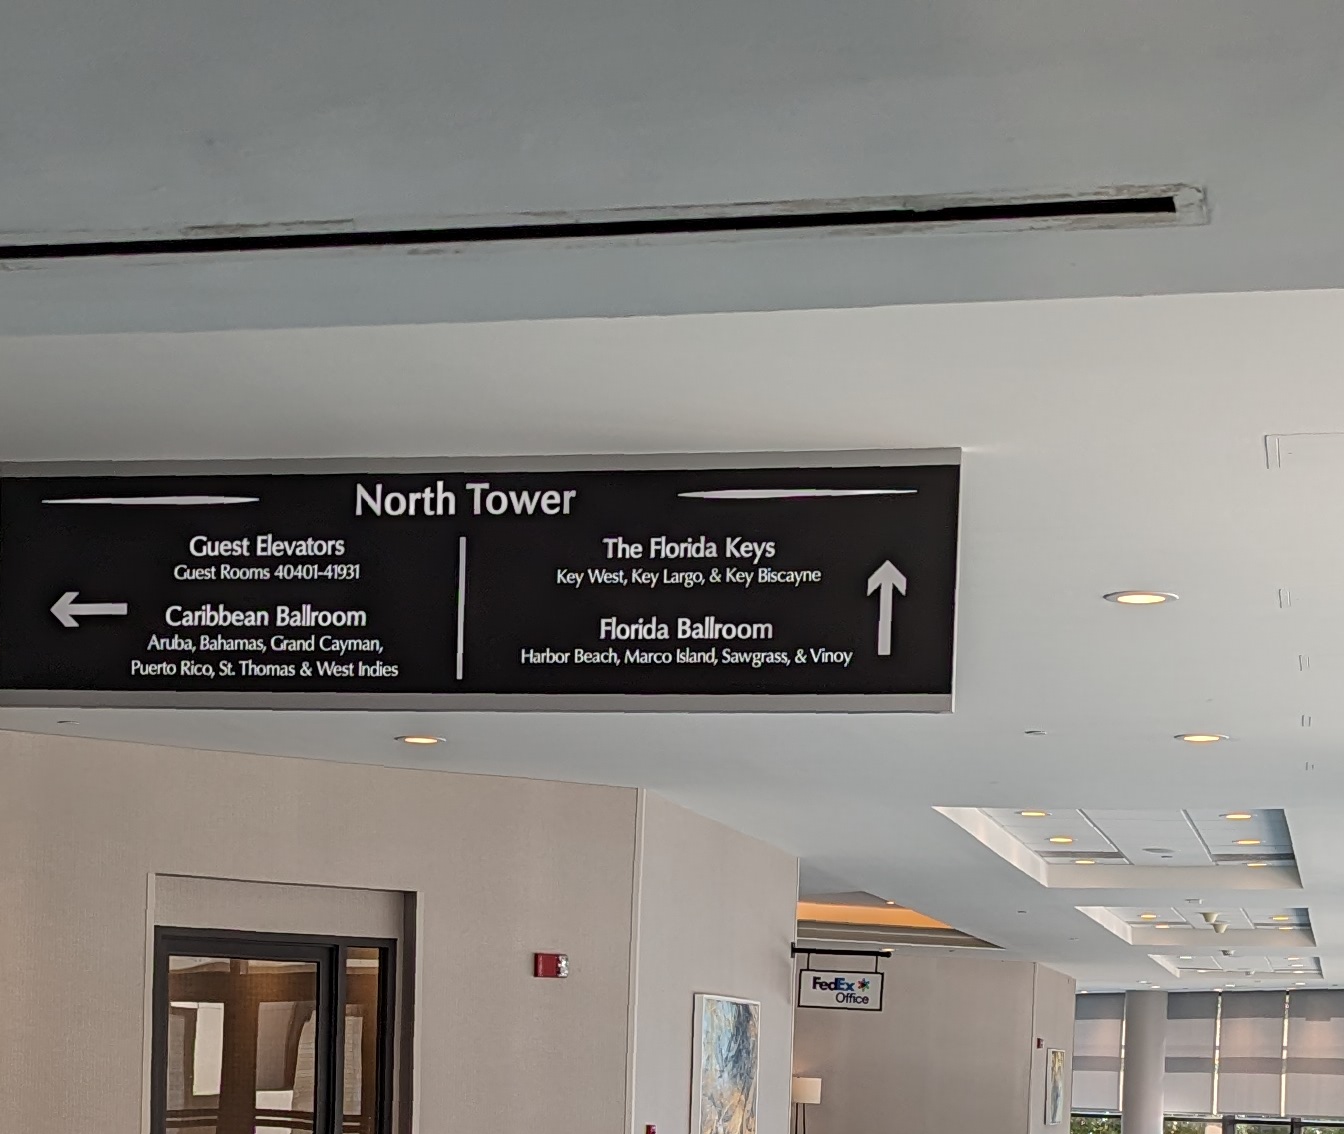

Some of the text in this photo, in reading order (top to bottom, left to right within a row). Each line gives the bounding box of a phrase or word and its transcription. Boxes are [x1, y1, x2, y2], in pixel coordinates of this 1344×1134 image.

[356, 481, 576, 516] North Tower
[189, 534, 345, 557] Guest Elevators
[603, 536, 776, 564] The Florida Keys
[174, 564, 360, 580] Guest Rooms 40401-41931
[557, 568, 822, 587] Key West, Key Largo, & Key Biscayne
[165, 604, 367, 627] Caribbean Ballroom
[600, 616, 773, 640] Florida Ballroom
[147, 634, 384, 656] Aruba, Bahamas, Grand Cayman,
[522, 648, 853, 668] Harbor Beach, Marco Island, Sawgrass, & Vinoy
[131, 660, 399, 679] Puerto Rico, St. Thomas & West Indies
[812, 976, 855, 991] FedEx
[836, 992, 869, 1004] Office
